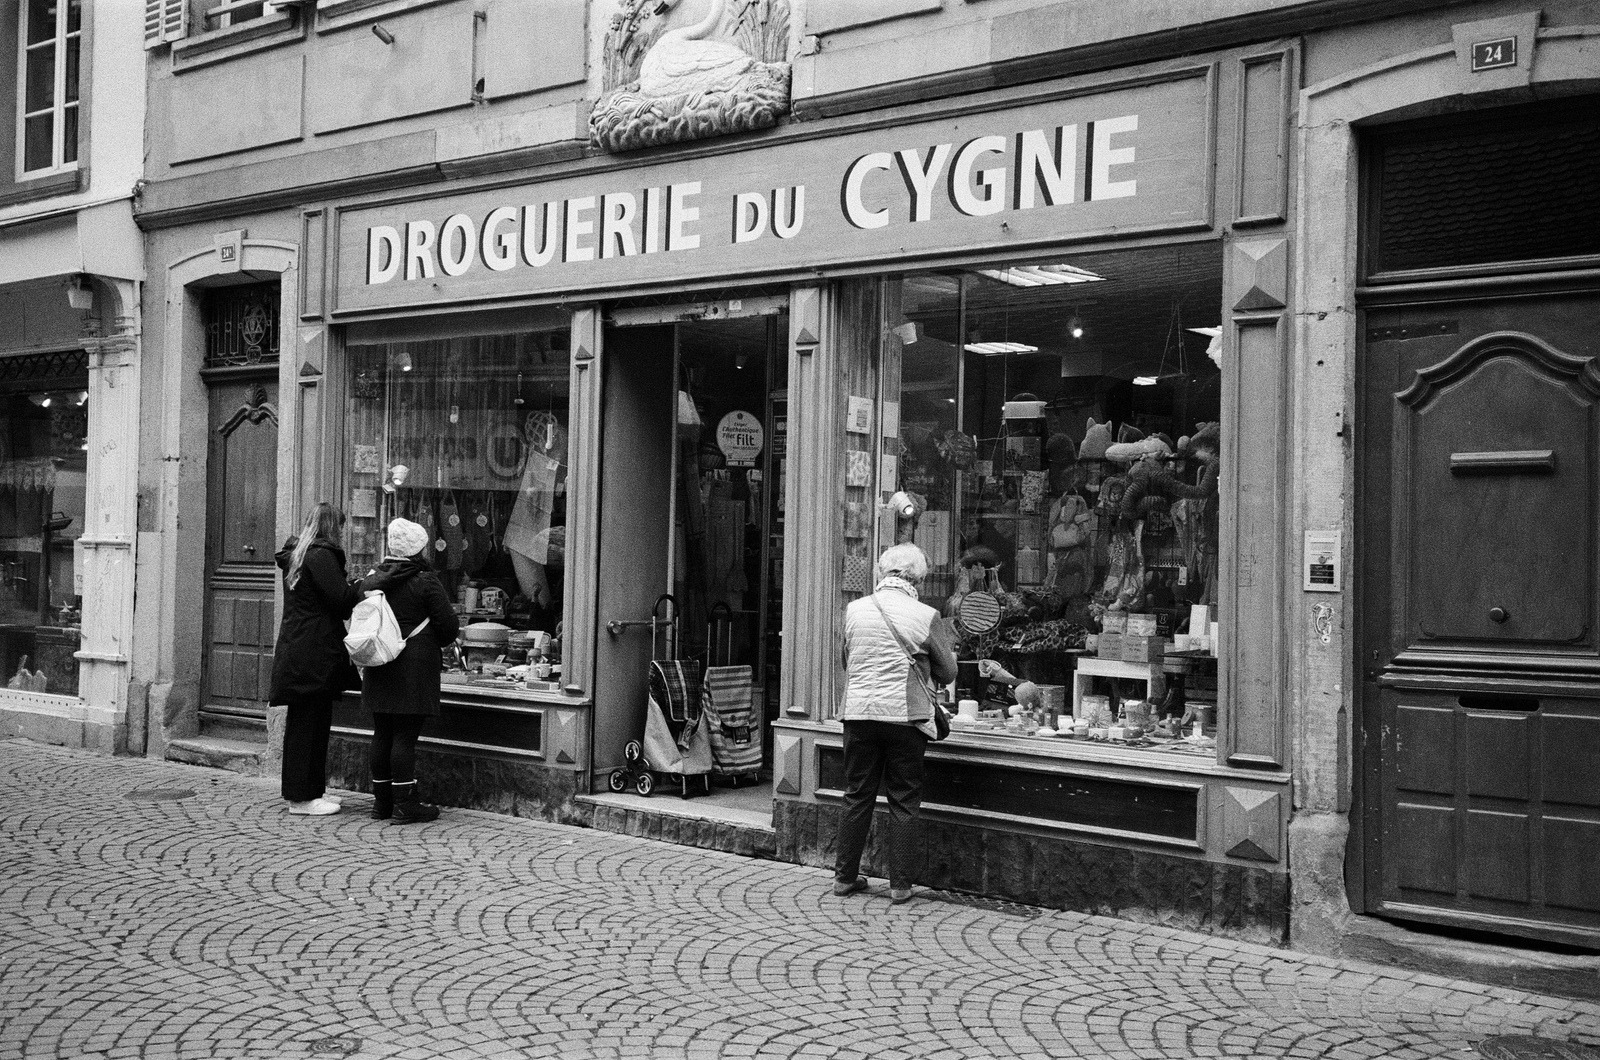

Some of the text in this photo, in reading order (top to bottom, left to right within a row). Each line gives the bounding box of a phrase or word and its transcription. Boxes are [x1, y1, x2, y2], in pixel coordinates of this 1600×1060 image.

[1484, 45, 1502, 63] 24
[366, 115, 1138, 285] DROGUERIE DU CYGNE
[737, 433, 755, 446] filt
